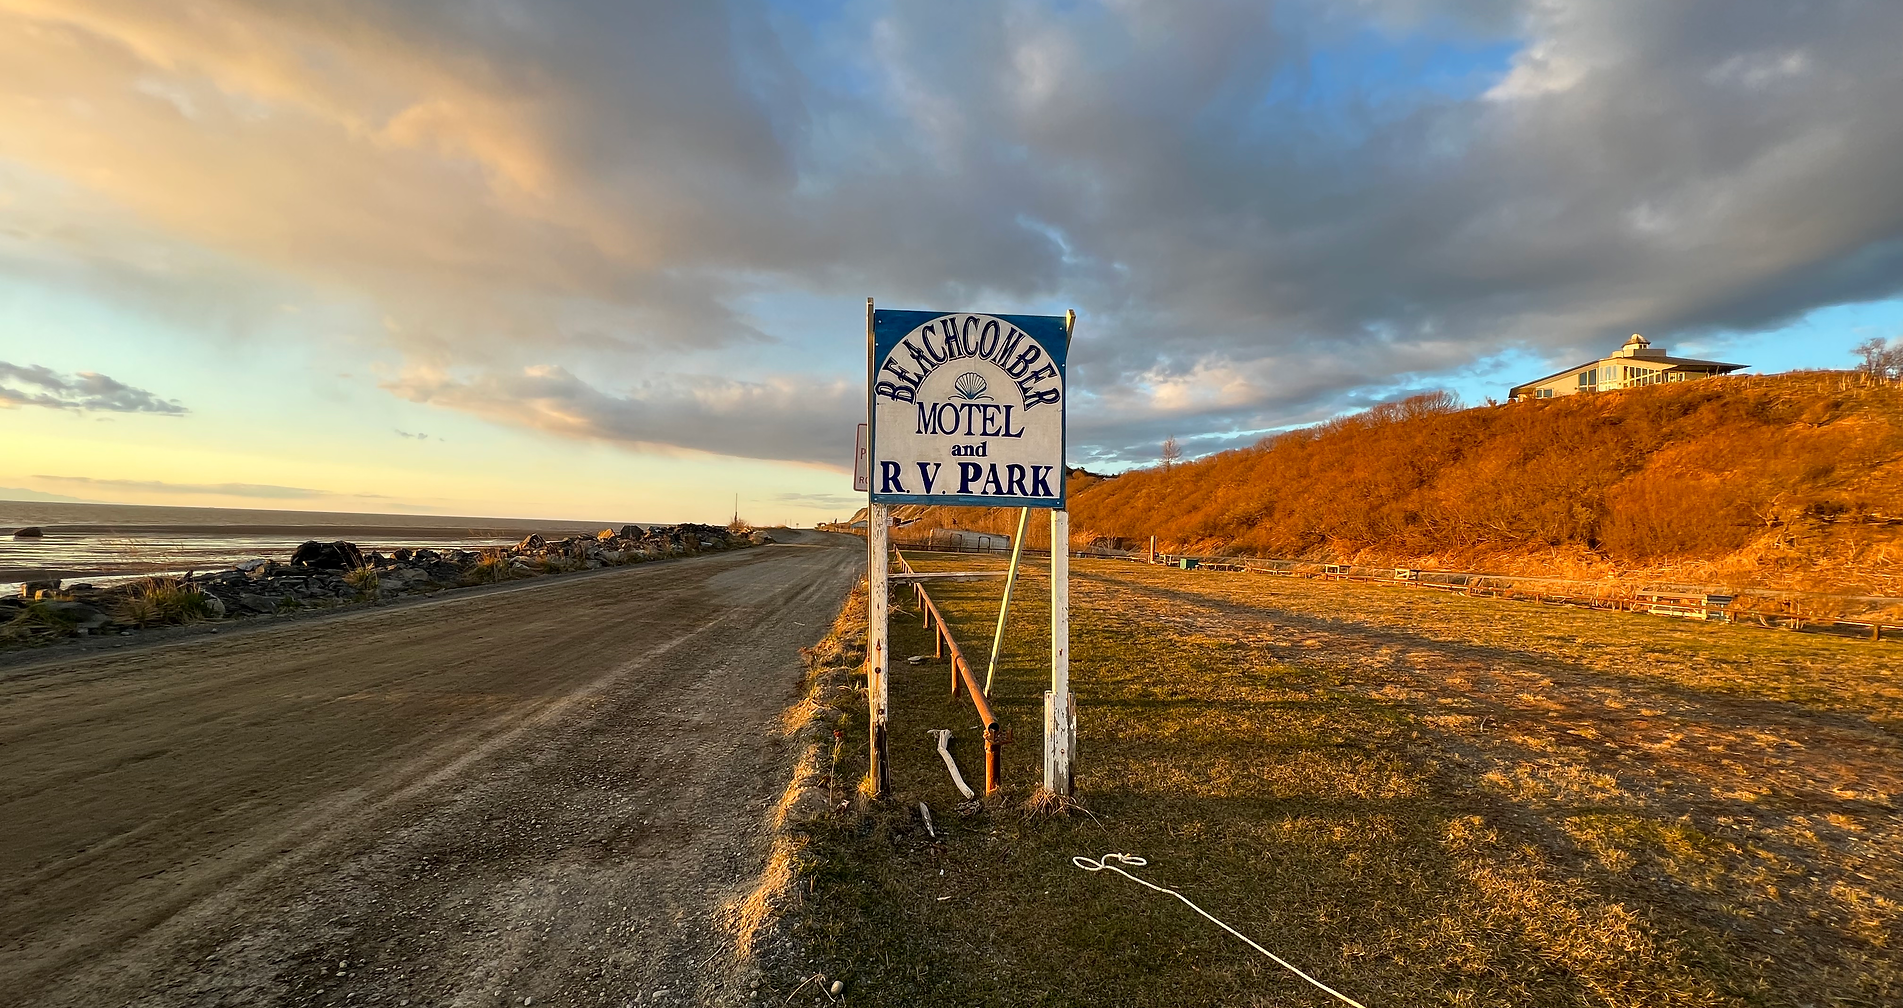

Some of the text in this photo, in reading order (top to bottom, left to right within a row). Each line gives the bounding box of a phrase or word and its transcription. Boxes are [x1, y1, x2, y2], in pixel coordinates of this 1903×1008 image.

[875, 315, 1060, 411] BEACHCOMBER
[915, 401, 1025, 438] MOTEL
[951, 441, 988, 457] and
[956, 462, 1054, 496] PARK
